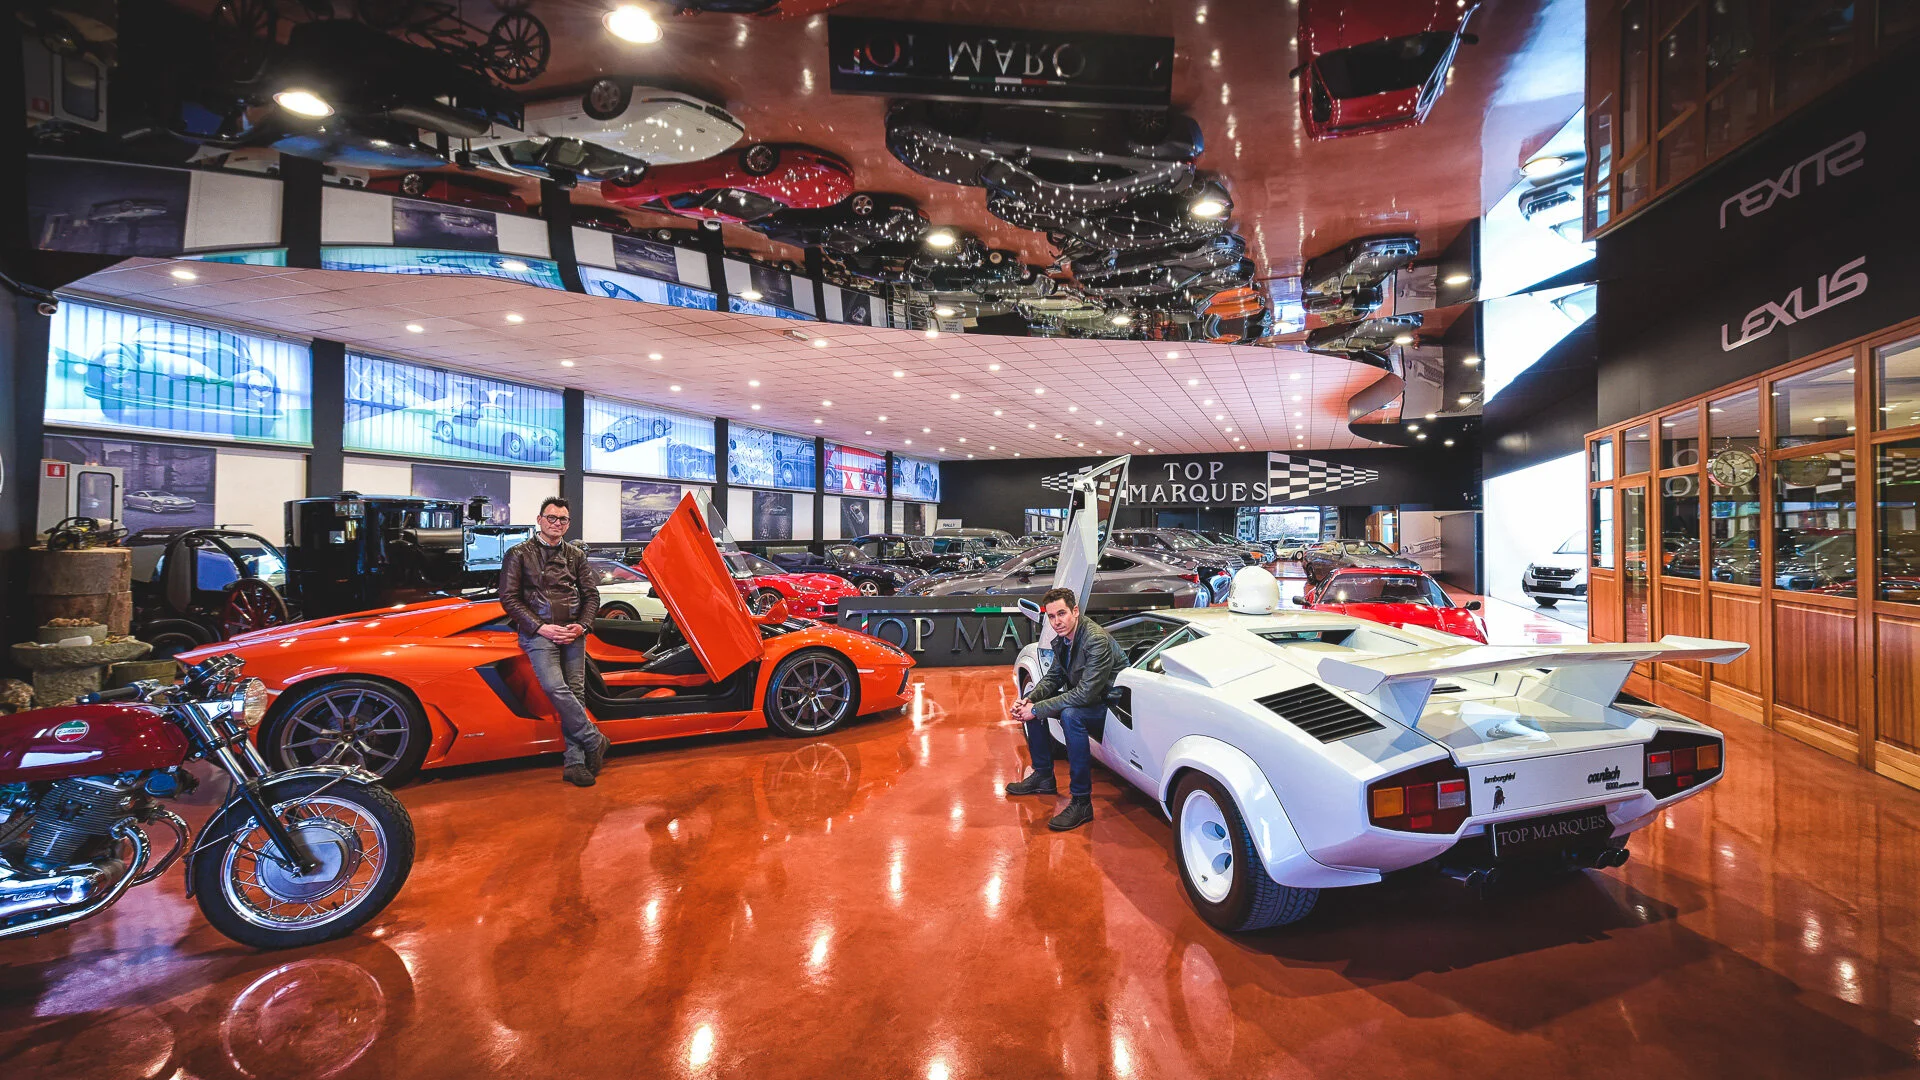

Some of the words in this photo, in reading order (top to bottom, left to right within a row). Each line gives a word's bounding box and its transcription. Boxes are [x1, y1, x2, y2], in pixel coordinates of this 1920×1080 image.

[1721, 255, 1869, 352] LEXUS
[1163, 461, 1225, 482] TOP
[1129, 482, 1268, 504] MARQUES
[1498, 827, 1529, 846] TOP
[1532, 814, 1606, 840] MARQUES
